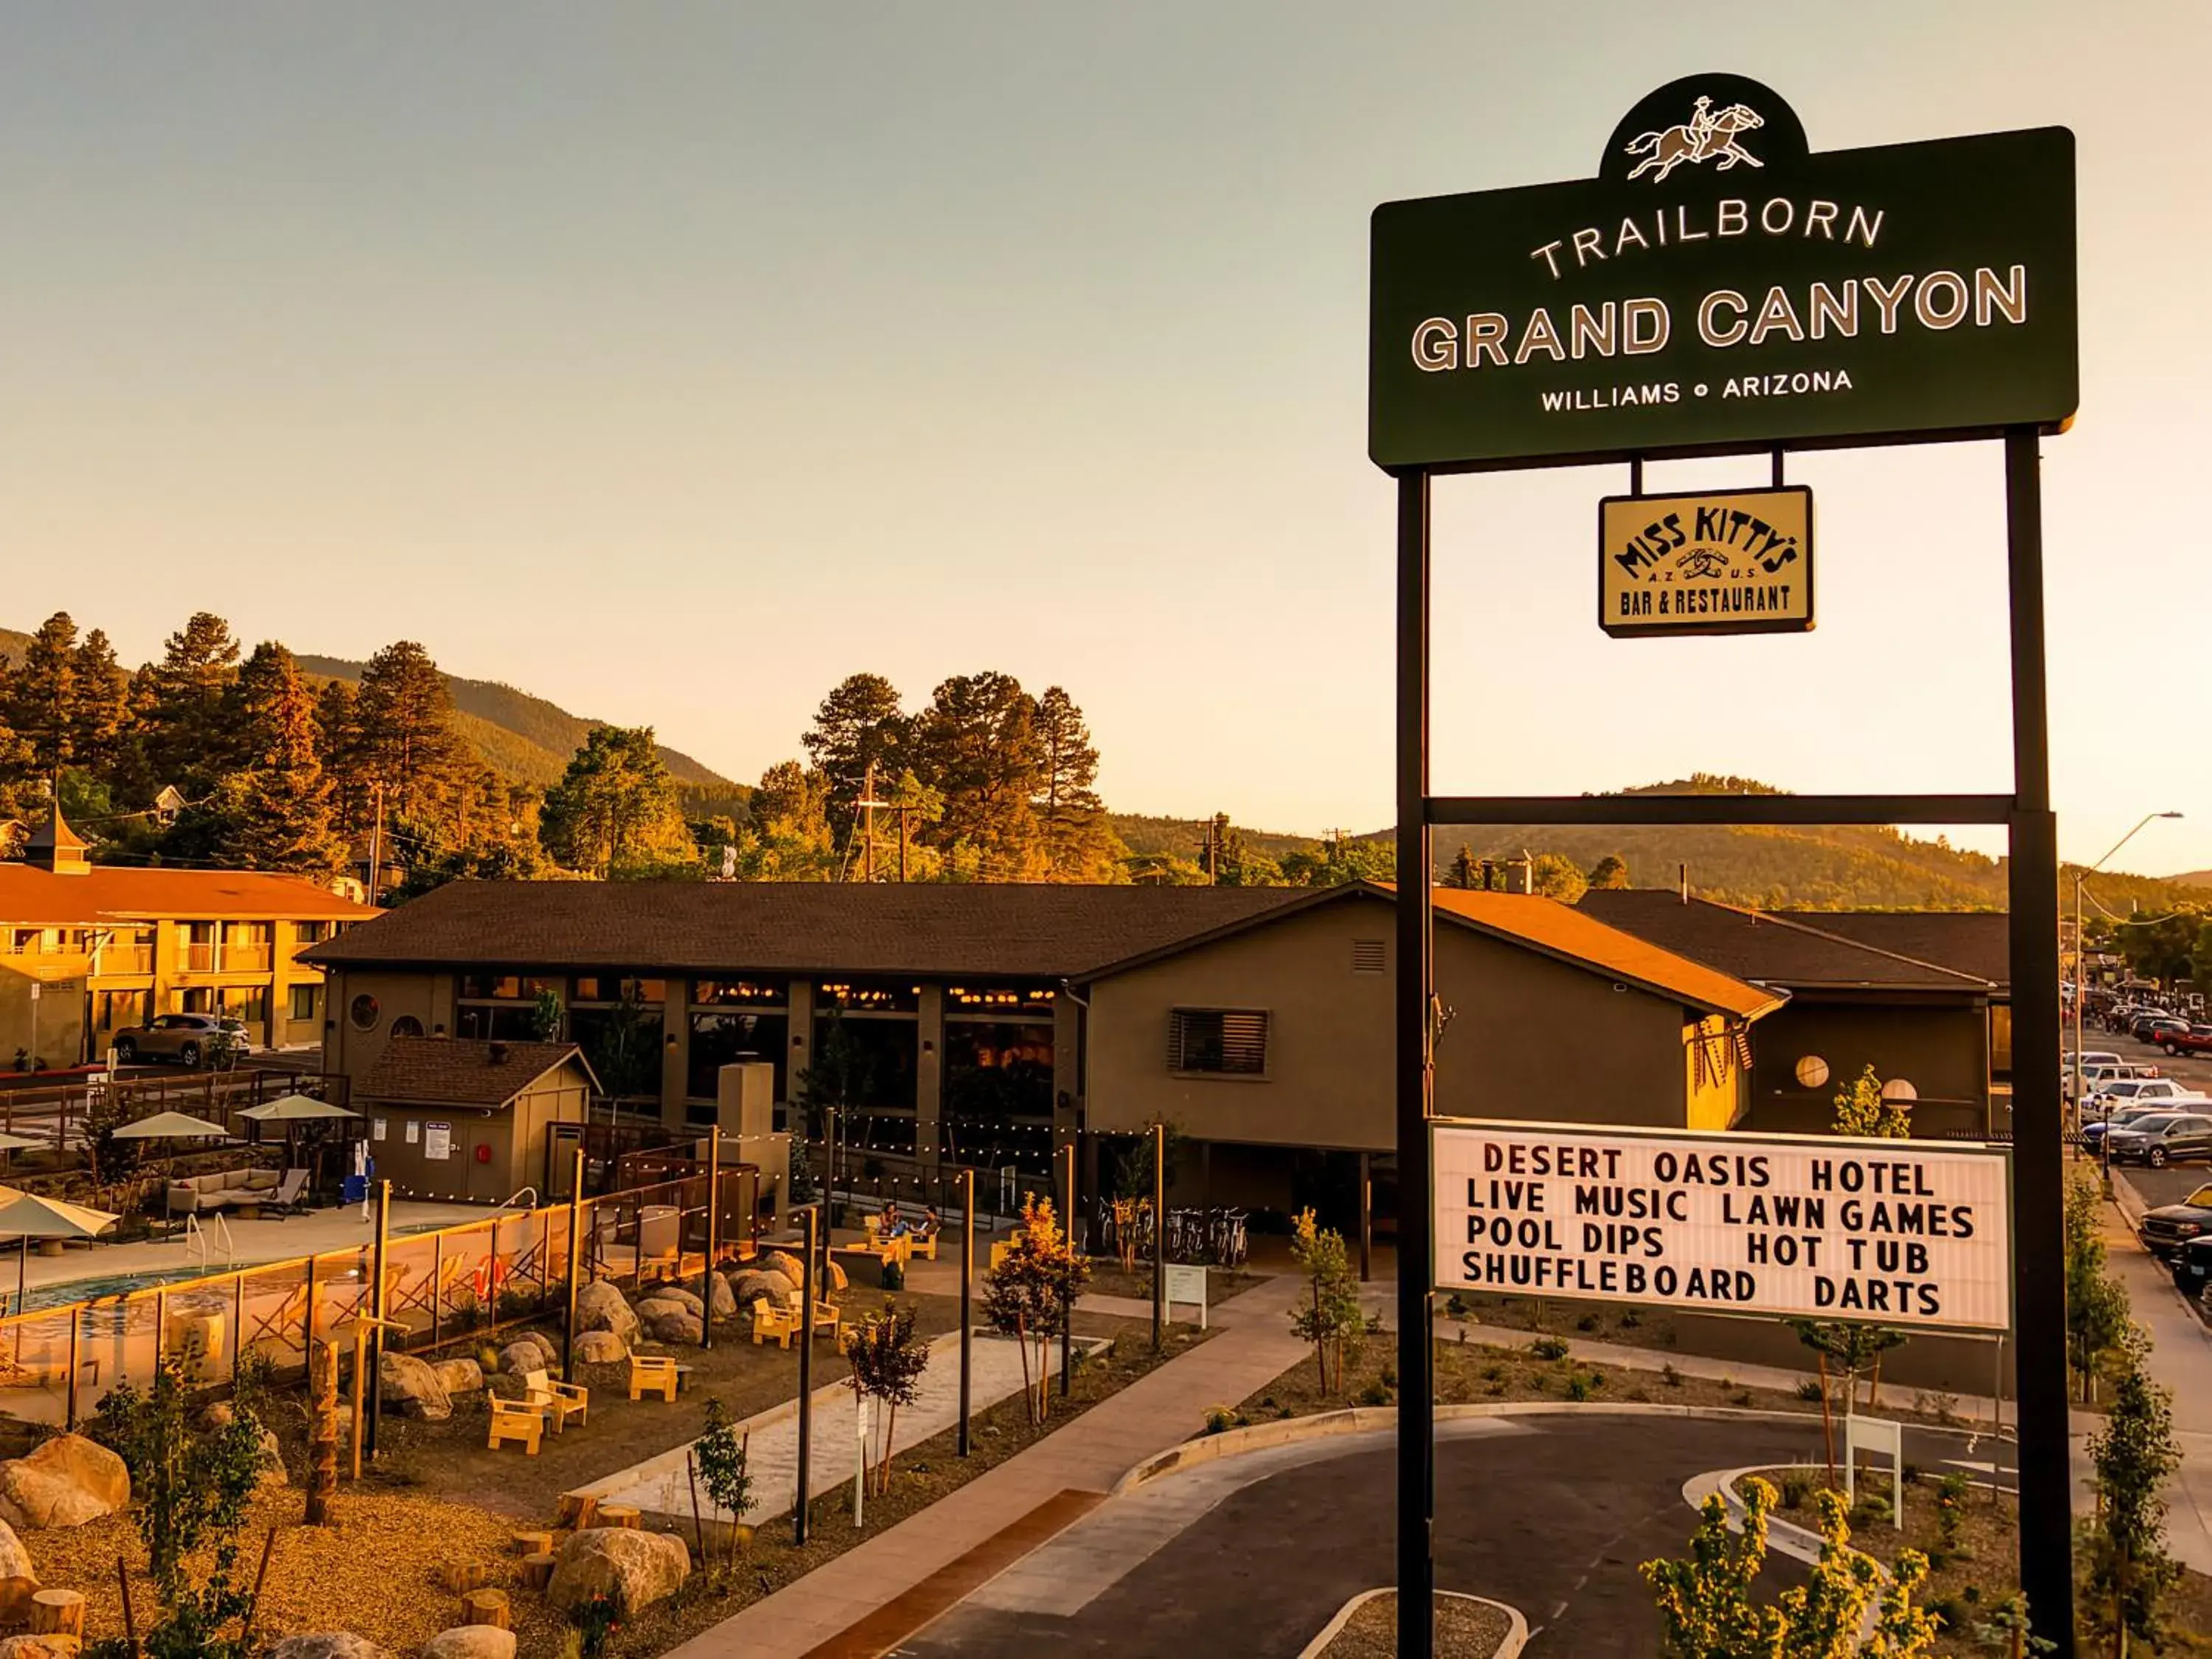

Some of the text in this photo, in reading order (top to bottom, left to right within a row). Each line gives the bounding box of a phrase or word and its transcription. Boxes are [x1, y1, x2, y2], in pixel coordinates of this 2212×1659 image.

[1530, 197, 1885, 280] TRAILBORN
[1411, 264, 2027, 372] GRAND CANYON
[1541, 369, 1853, 412] WILLIAMS ARIZONA
[1614, 512, 1686, 580] MISS
[1621, 585, 1790, 616] BAR & RESTAURANT
[1484, 1143, 1934, 1197] DESERT OASIS HOTEL
[1467, 1178, 1974, 1239] LIVE MUSIC LAWN GAMES
[1467, 1214, 1929, 1274] POOL DIPS HOT TUB
[1462, 1251, 1940, 1316] SHUFFLEBOARD DARTS
